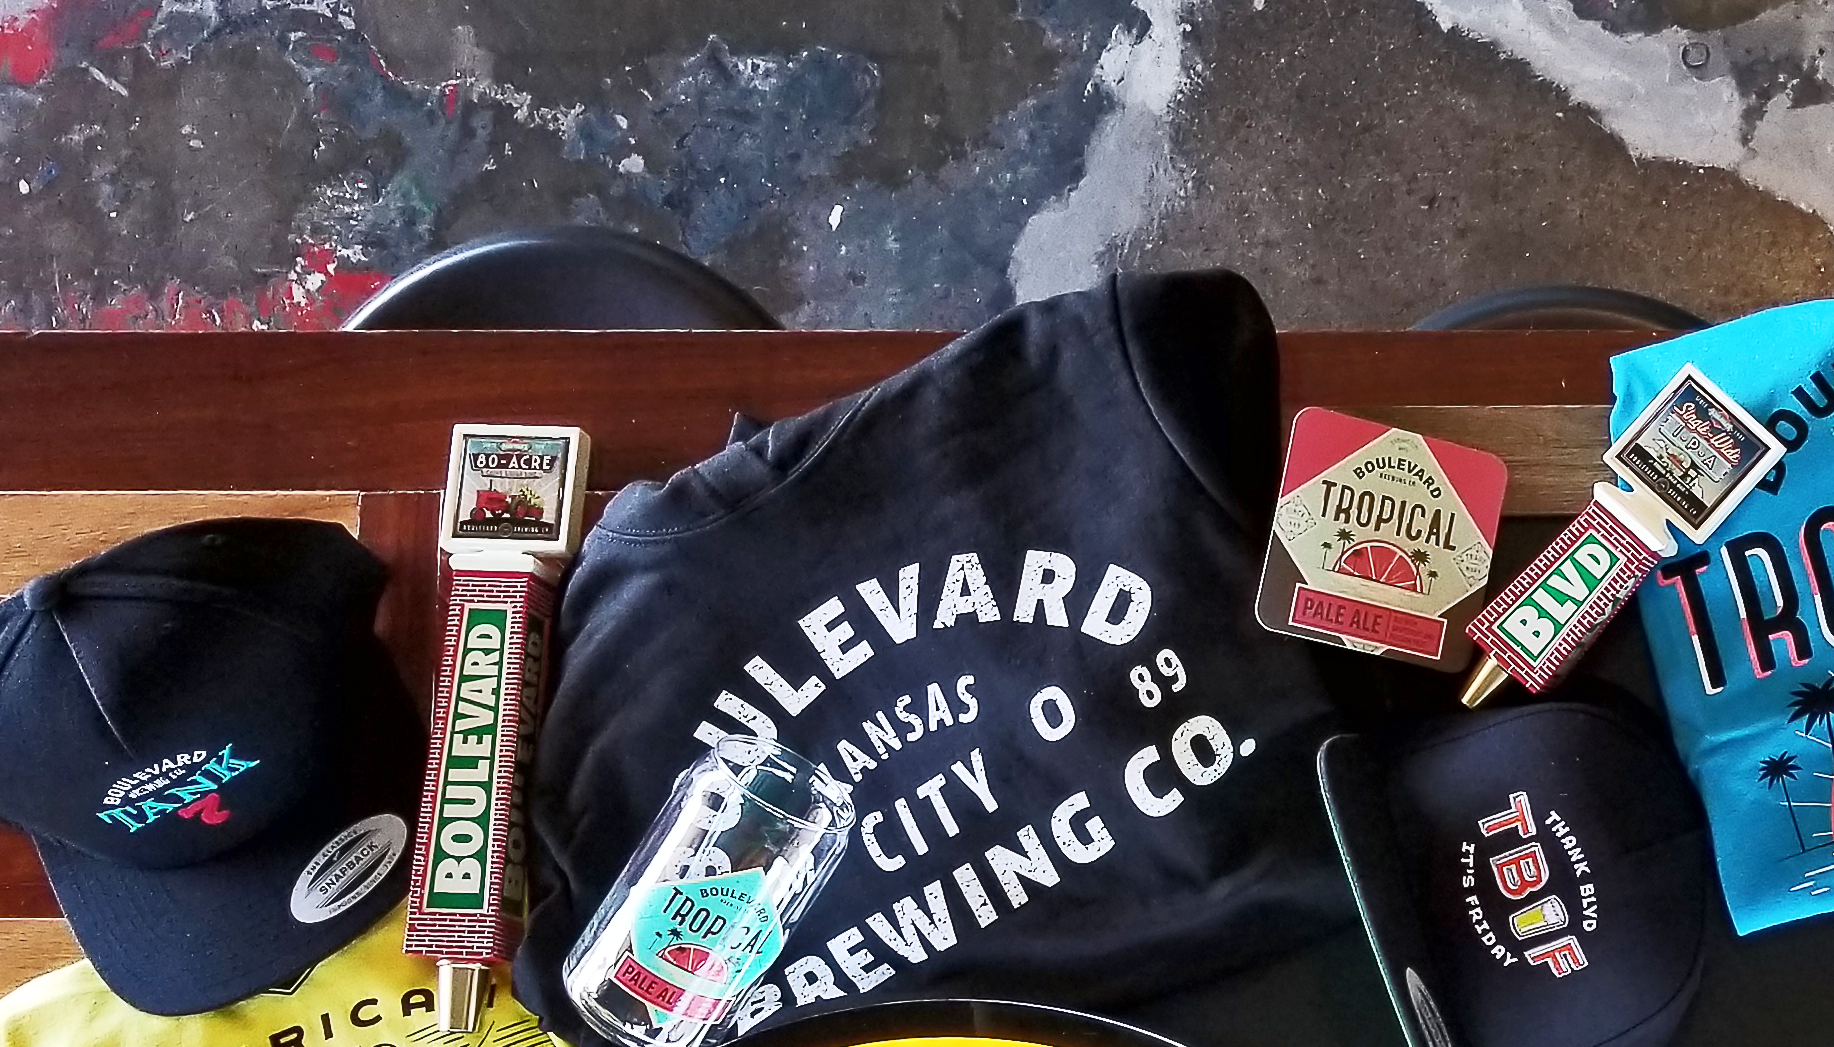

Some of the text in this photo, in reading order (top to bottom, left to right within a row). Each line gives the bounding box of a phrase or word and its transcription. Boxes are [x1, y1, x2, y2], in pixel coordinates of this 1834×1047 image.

[476, 453, 552, 470] 80-ACRE
[1353, 456, 1442, 500] BOULEVARD
[1321, 479, 1457, 552] TROPICAL
[1302, 597, 1345, 626] PALE
[1352, 610, 1384, 634] ALE
[1502, 542, 1613, 657] BLVD
[1128, 647, 1188, 708] 89
[96, 743, 261, 833] TANK
[103, 750, 208, 807] BOULEVARD
[434, 622, 502, 895] BOULEVARD
[860, 748, 1000, 873] CITY
[319, 841, 382, 897] SNAPBACK
[730, 714, 1257, 1037] BREWING CO.
[1545, 810, 1599, 933] THANK BLVD
[663, 886, 773, 955] TROPCAL
[700, 887, 769, 923] BOULEVRD
[1460, 841, 1520, 968] IT'S FRIDAY
[622, 963, 657, 998] PALE
